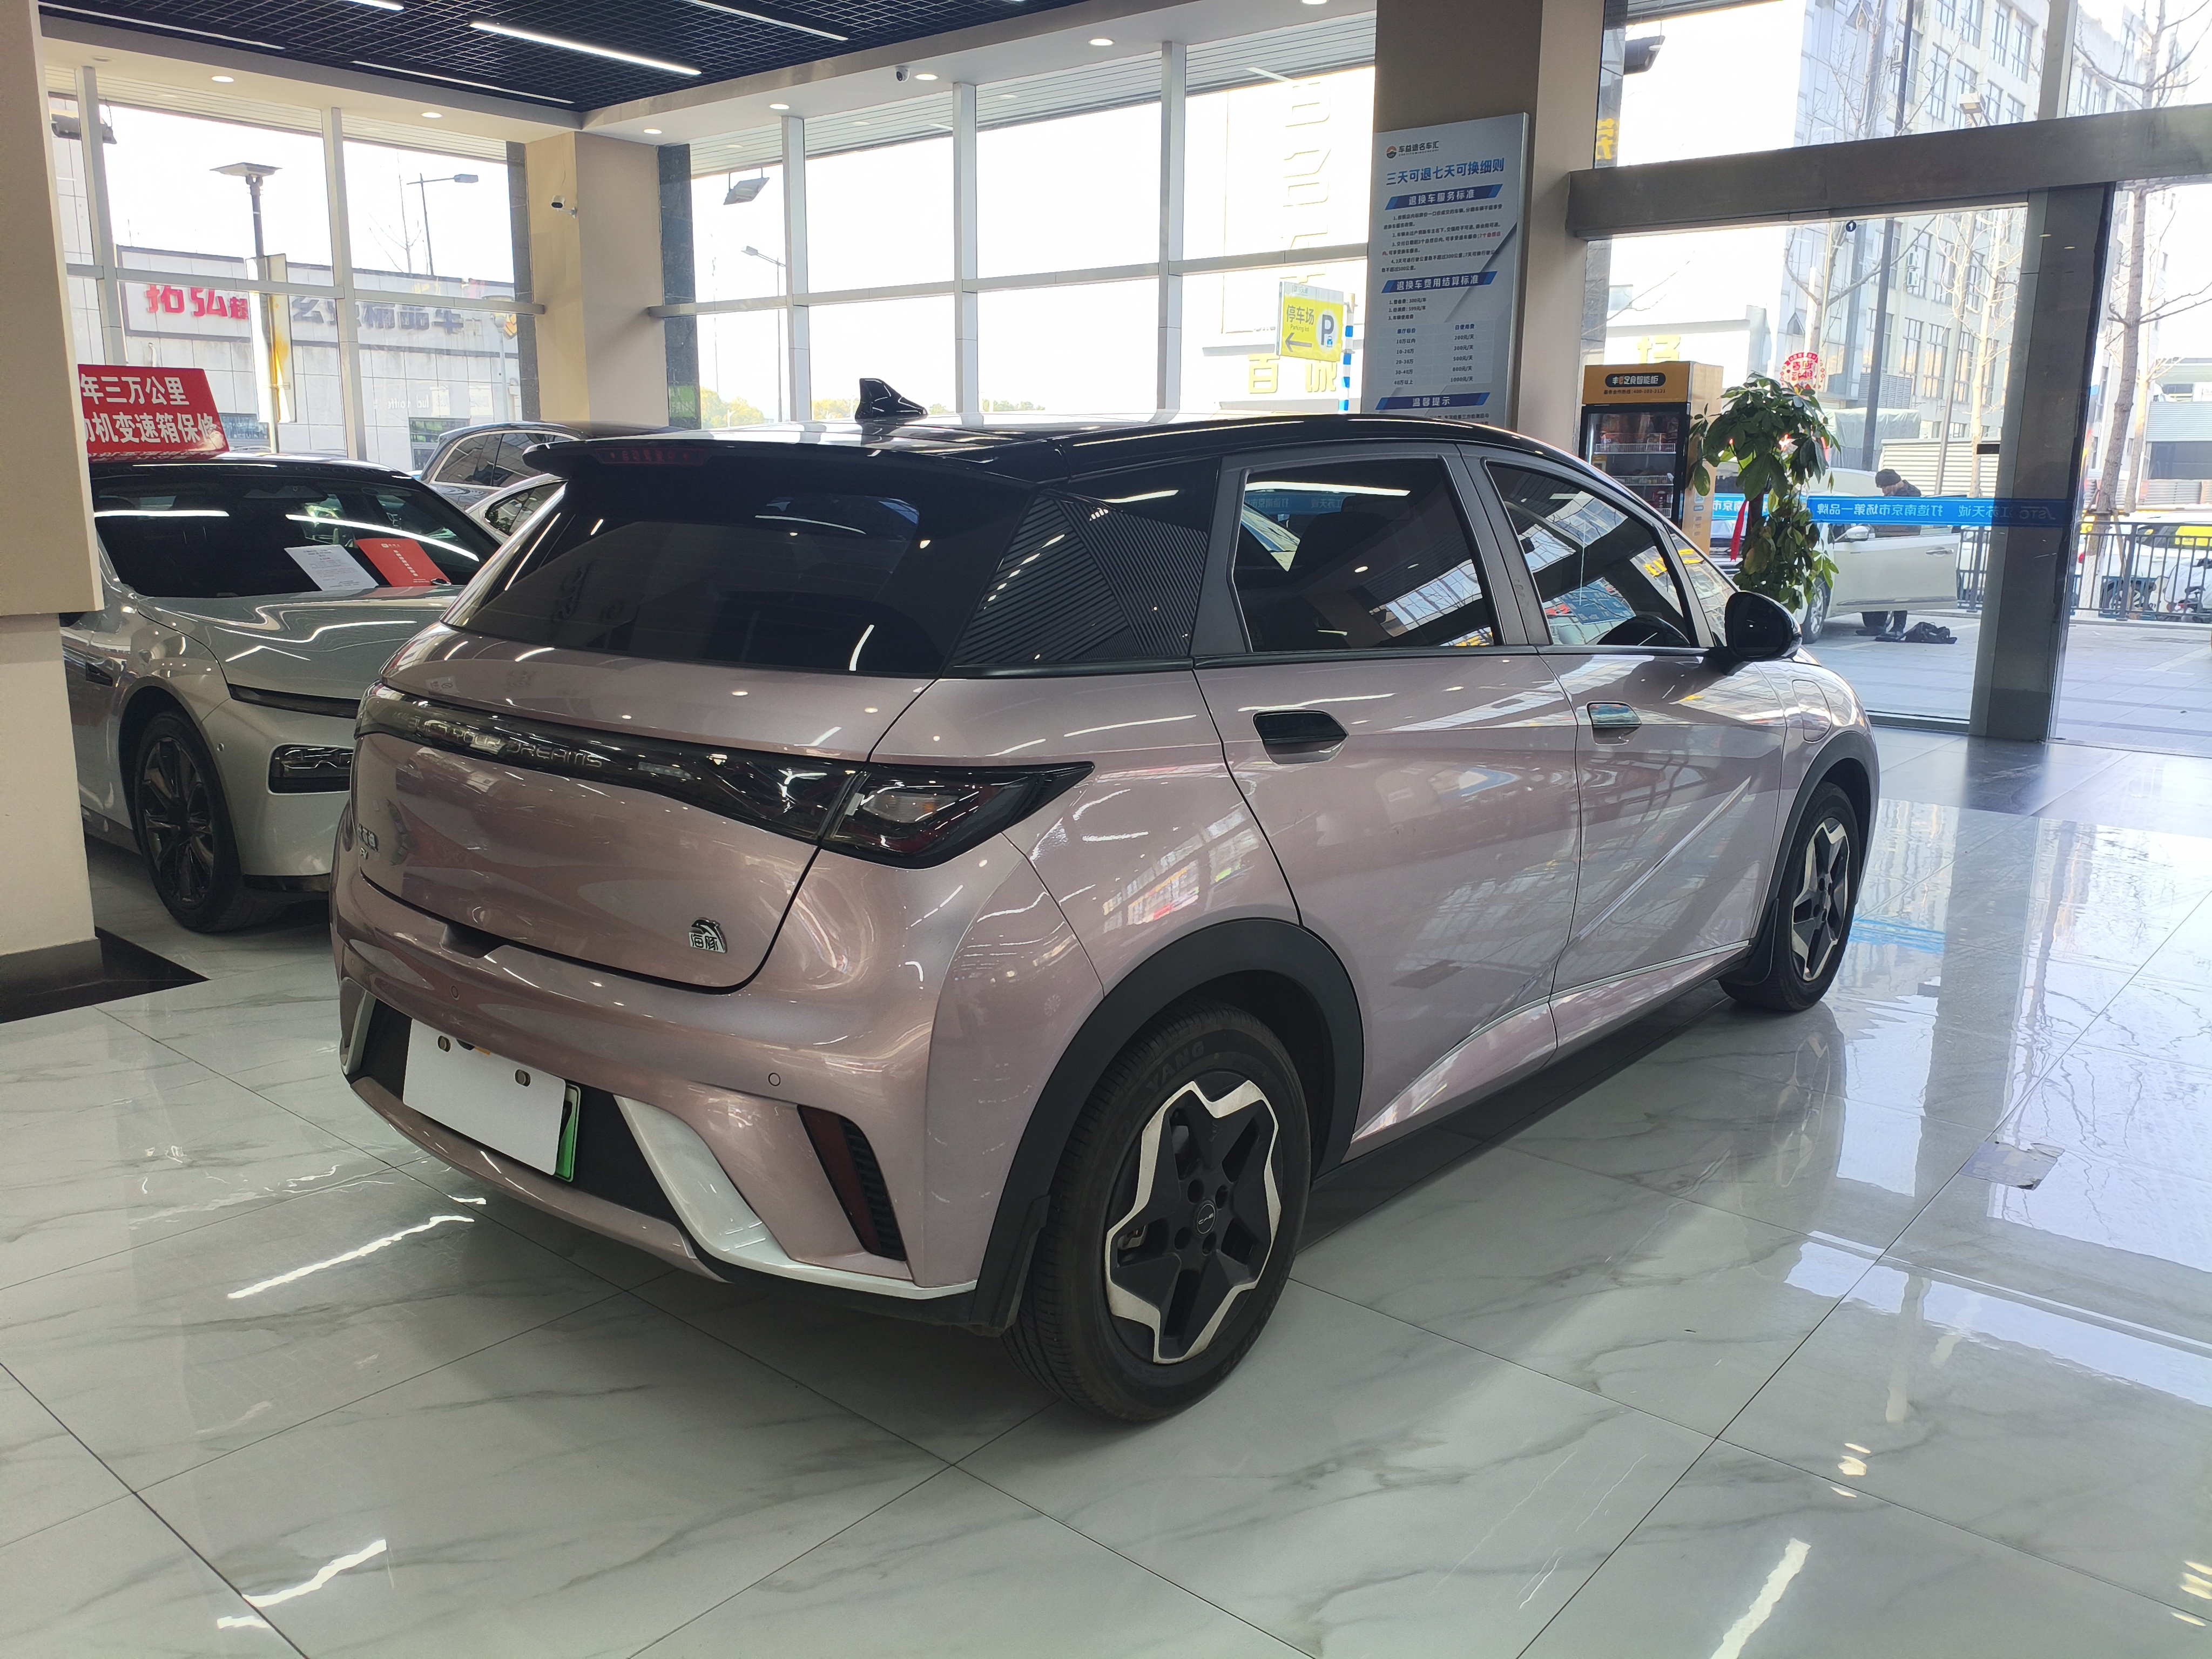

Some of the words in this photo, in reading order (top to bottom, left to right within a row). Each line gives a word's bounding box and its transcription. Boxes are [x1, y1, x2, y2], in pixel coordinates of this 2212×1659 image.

[1386, 158, 1505, 185] 三天可退七天可换细则
[1409, 189, 1475, 205] 退换车服务标准
[1397, 274, 1479, 291] 退换车费用结算标准
[1286, 305, 1314, 326] 停车场
[1290, 323, 1304, 332] Parking
[1321, 314, 1334, 346] P
[80, 373, 190, 405] 年三万公里
[1413, 396, 1451, 407] 温馨提示
[506, 739, 602, 768] DREAMS
[691, 933, 719, 950] 海豚
